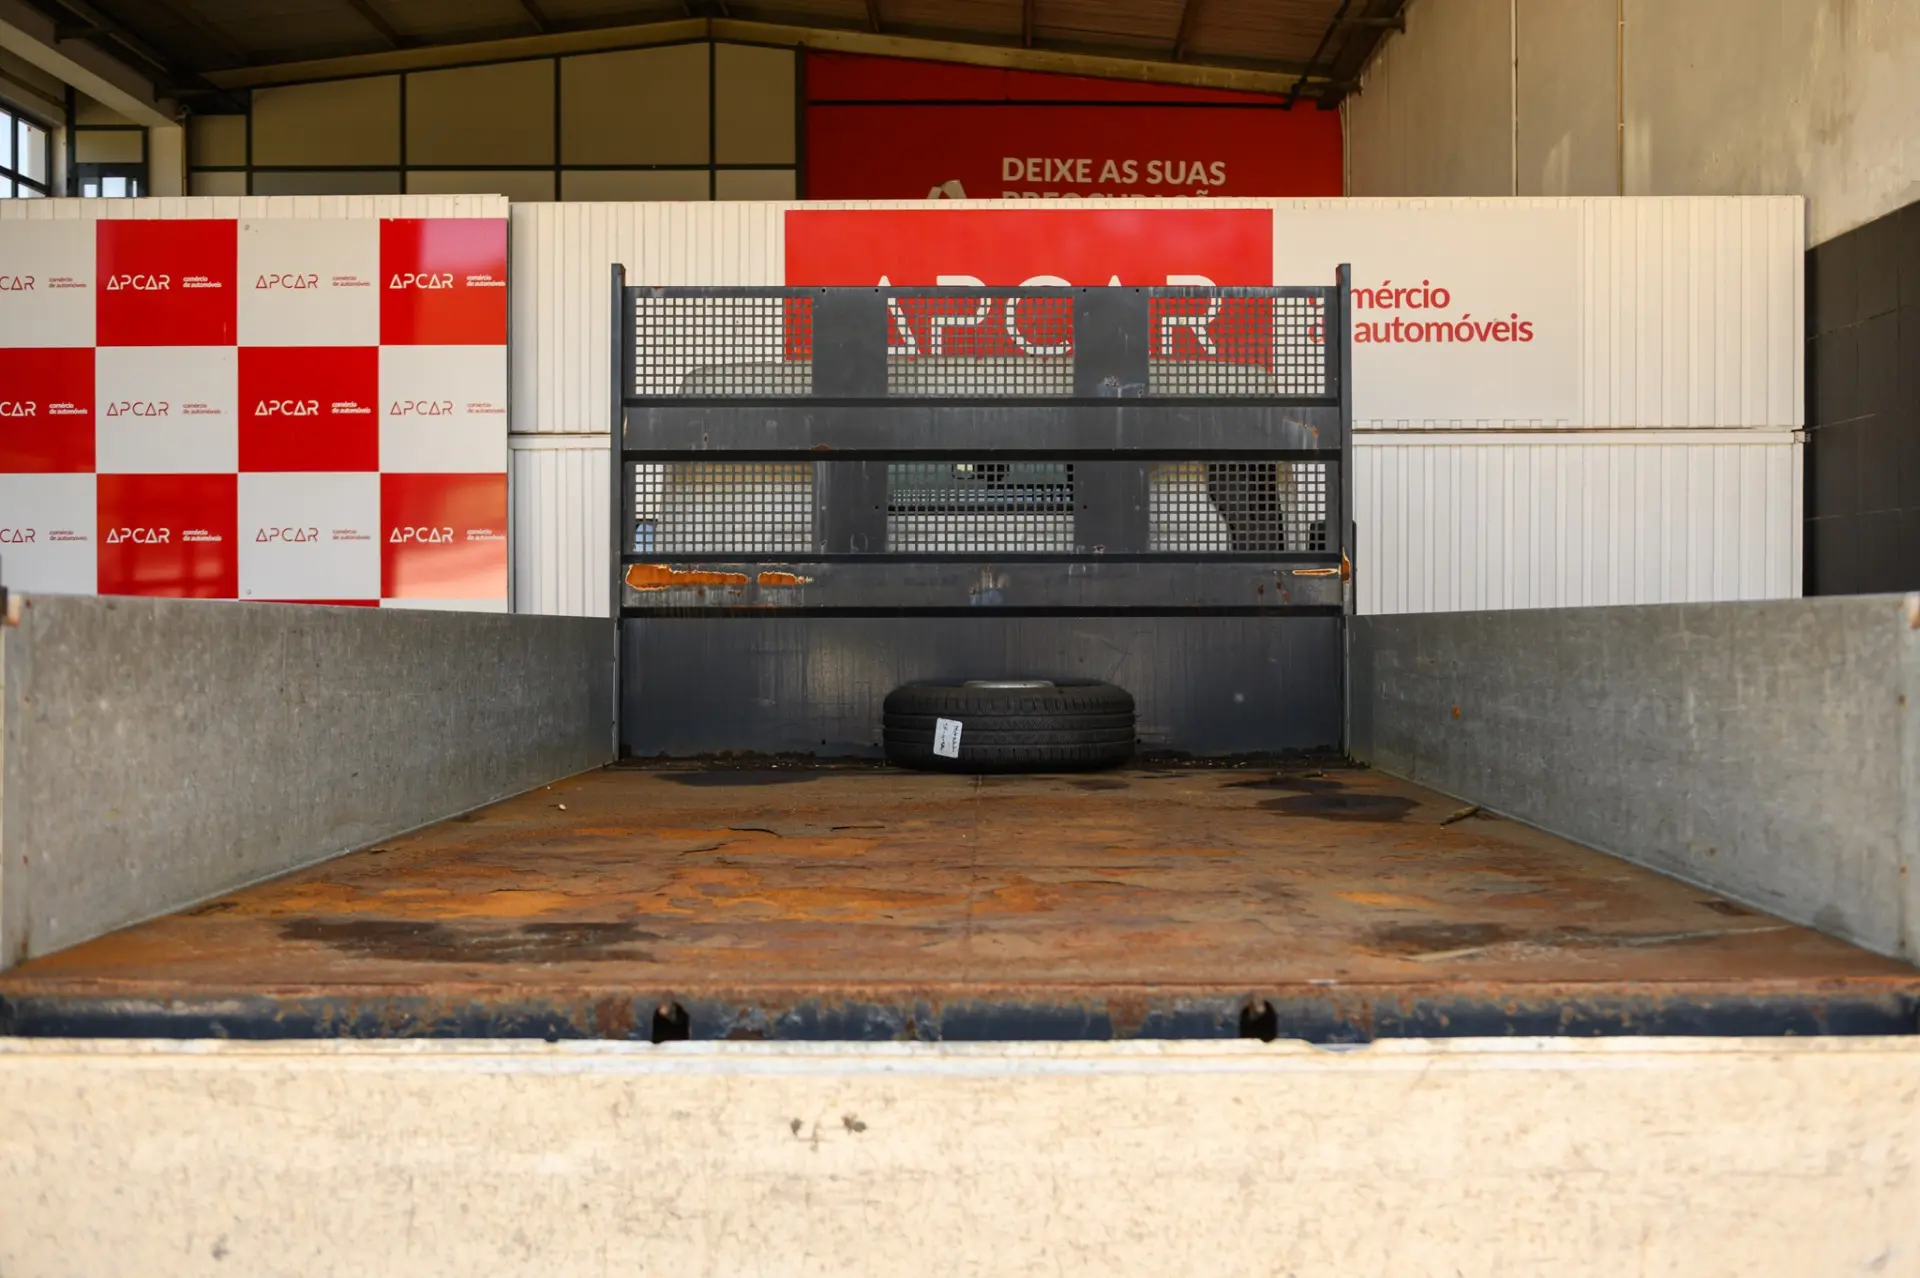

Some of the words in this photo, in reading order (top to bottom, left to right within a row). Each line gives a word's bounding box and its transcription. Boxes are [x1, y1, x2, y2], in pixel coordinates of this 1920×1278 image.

[1002, 157, 1093, 183] DEIXE
[1099, 159, 1139, 184] AS
[1145, 160, 1227, 186] SUAS
[106, 274, 171, 290] APCAR
[255, 274, 319, 289] APCAR
[389, 273, 454, 289] APCAR
[1353, 313, 1534, 343] automóveis
[106, 401, 169, 417] APCAR
[254, 400, 319, 416] APCAR
[389, 401, 453, 416] APCAR
[106, 528, 171, 543] APCAR
[255, 528, 319, 542] APCAR
[389, 527, 454, 543] APCAR
